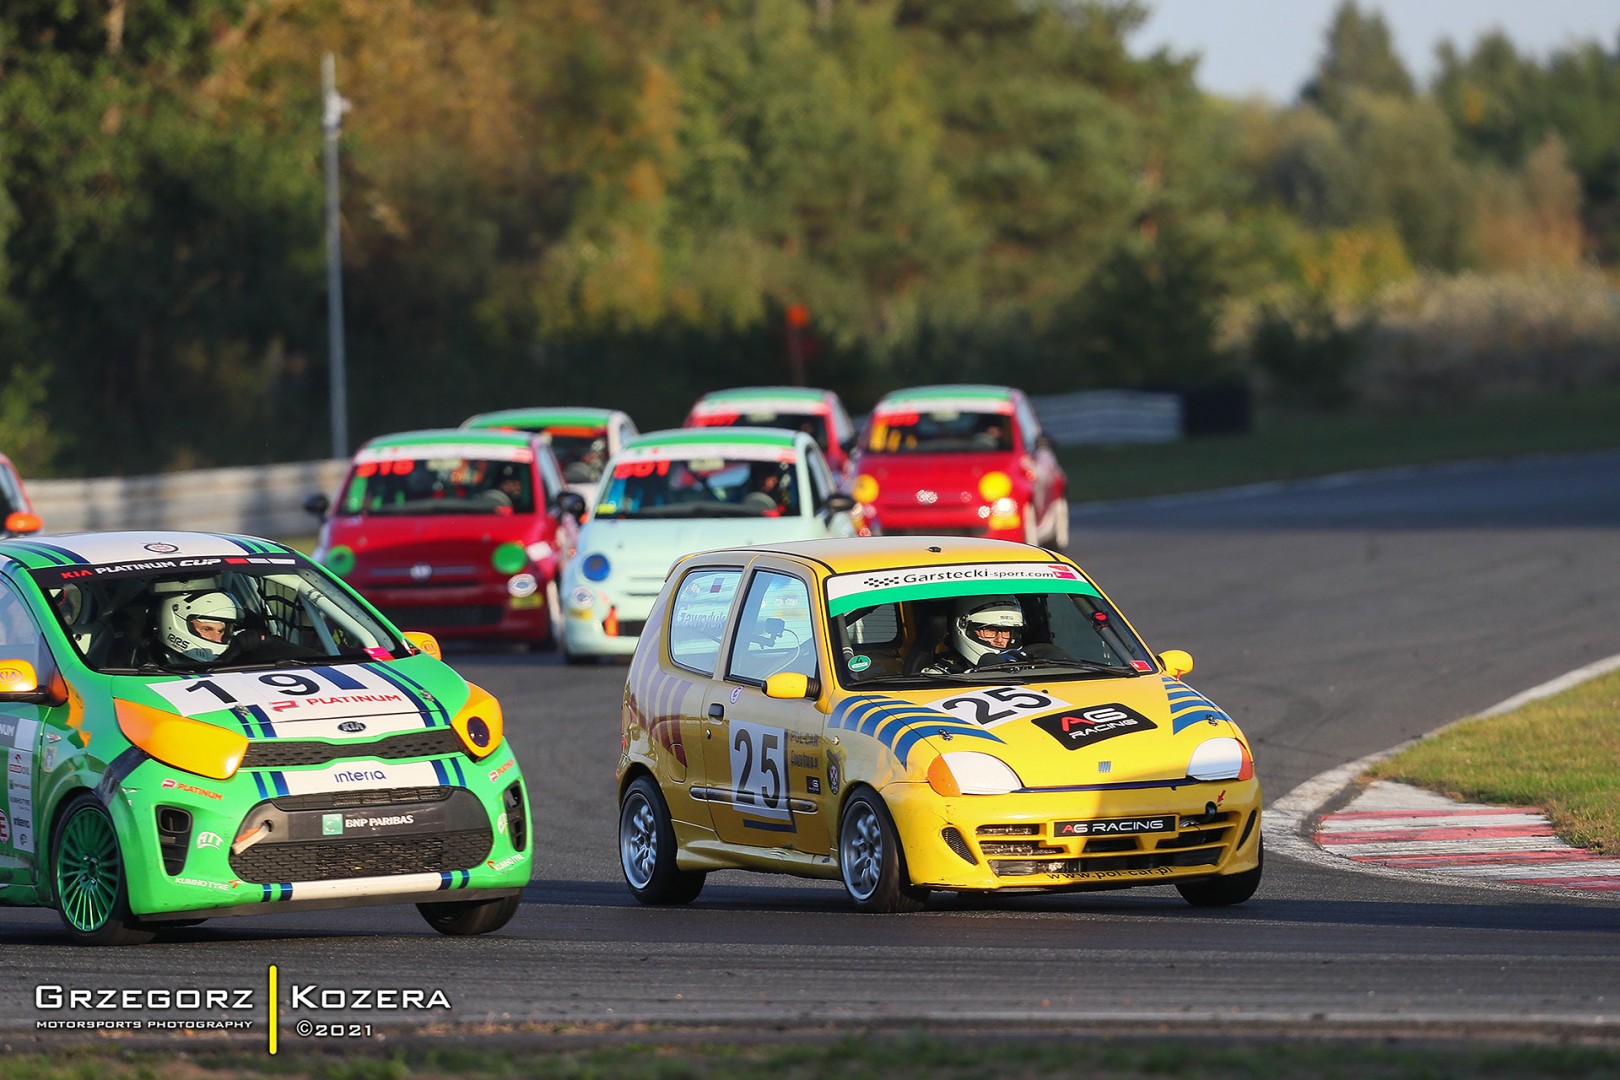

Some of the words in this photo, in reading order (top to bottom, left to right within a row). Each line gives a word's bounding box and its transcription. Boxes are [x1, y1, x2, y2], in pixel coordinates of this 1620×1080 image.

[61, 569, 92, 579] KIA
[96, 561, 175, 575] PLATINUM
[179, 558, 222, 566] CUP
[903, 568, 1054, 584] Garstecki-sport.com
[167, 633, 190, 649] RRS
[306, 694, 402, 706] PLATINUM
[942, 686, 1052, 726] 25
[1061, 708, 1129, 732] AG
[1069, 718, 1138, 740] RACING
[334, 768, 386, 784] interia
[734, 728, 781, 808] 25
[177, 783, 223, 801] PLATINUM
[344, 819, 367, 829] BNP
[369, 815, 413, 827] PARIBAS
[1062, 826, 1087, 834] AG
[1092, 820, 1163, 832] RACING
[1047, 866, 1173, 880] www.pol-car.pl
